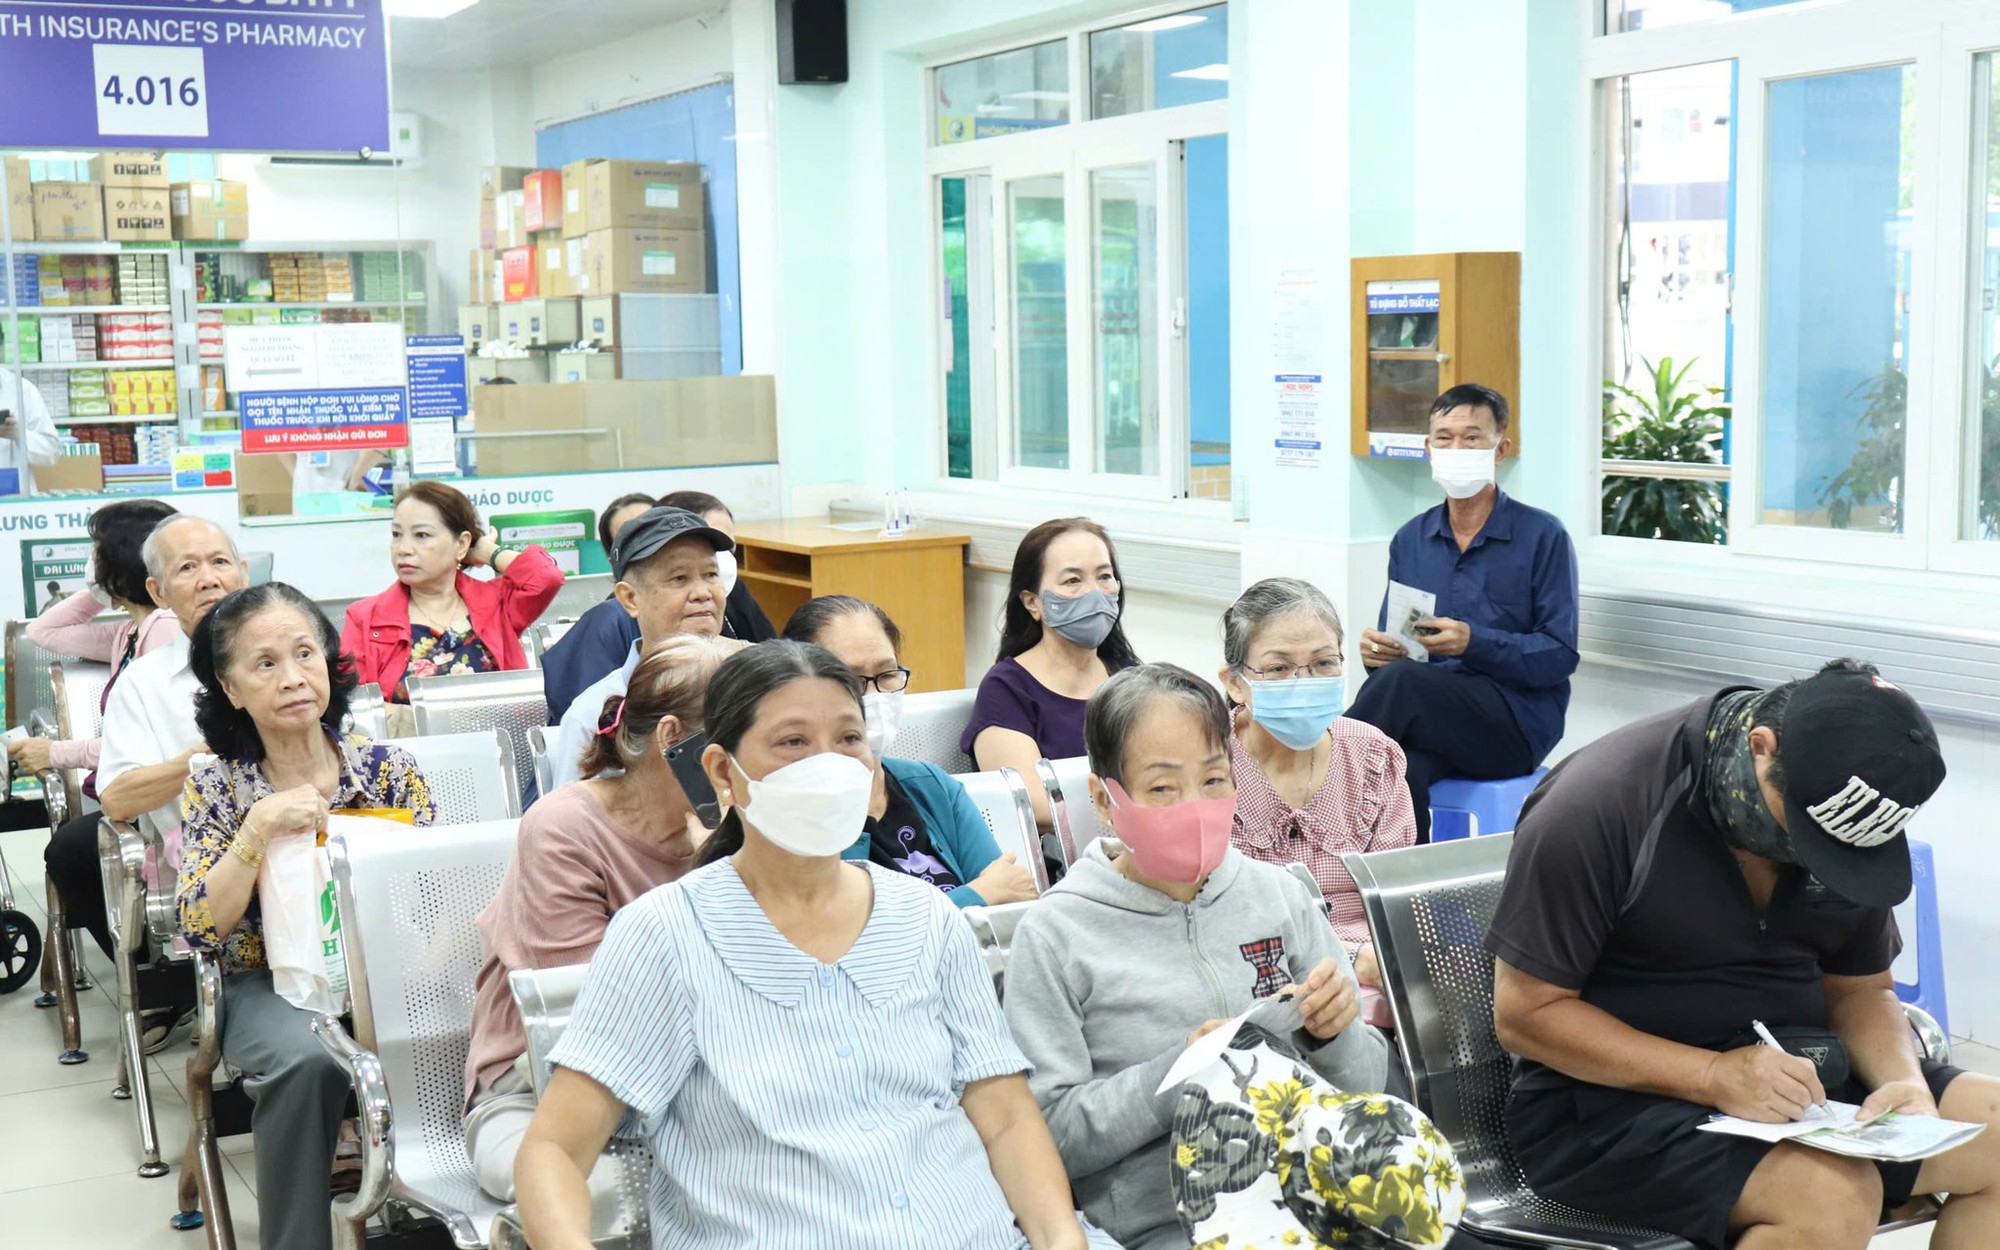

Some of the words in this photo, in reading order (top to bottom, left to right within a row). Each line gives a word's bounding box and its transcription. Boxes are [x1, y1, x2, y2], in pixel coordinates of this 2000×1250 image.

[40, 15, 218, 43] INSURANCE'S
[225, 23, 365, 48] PHARMACY
[104, 75, 199, 106] 4.016
[506, 489, 554, 507] DƯỢC
[0, 513, 48, 531] ƯNG
[43, 564, 62, 575] ĐAI
[64, 562, 85, 574] LƯN
